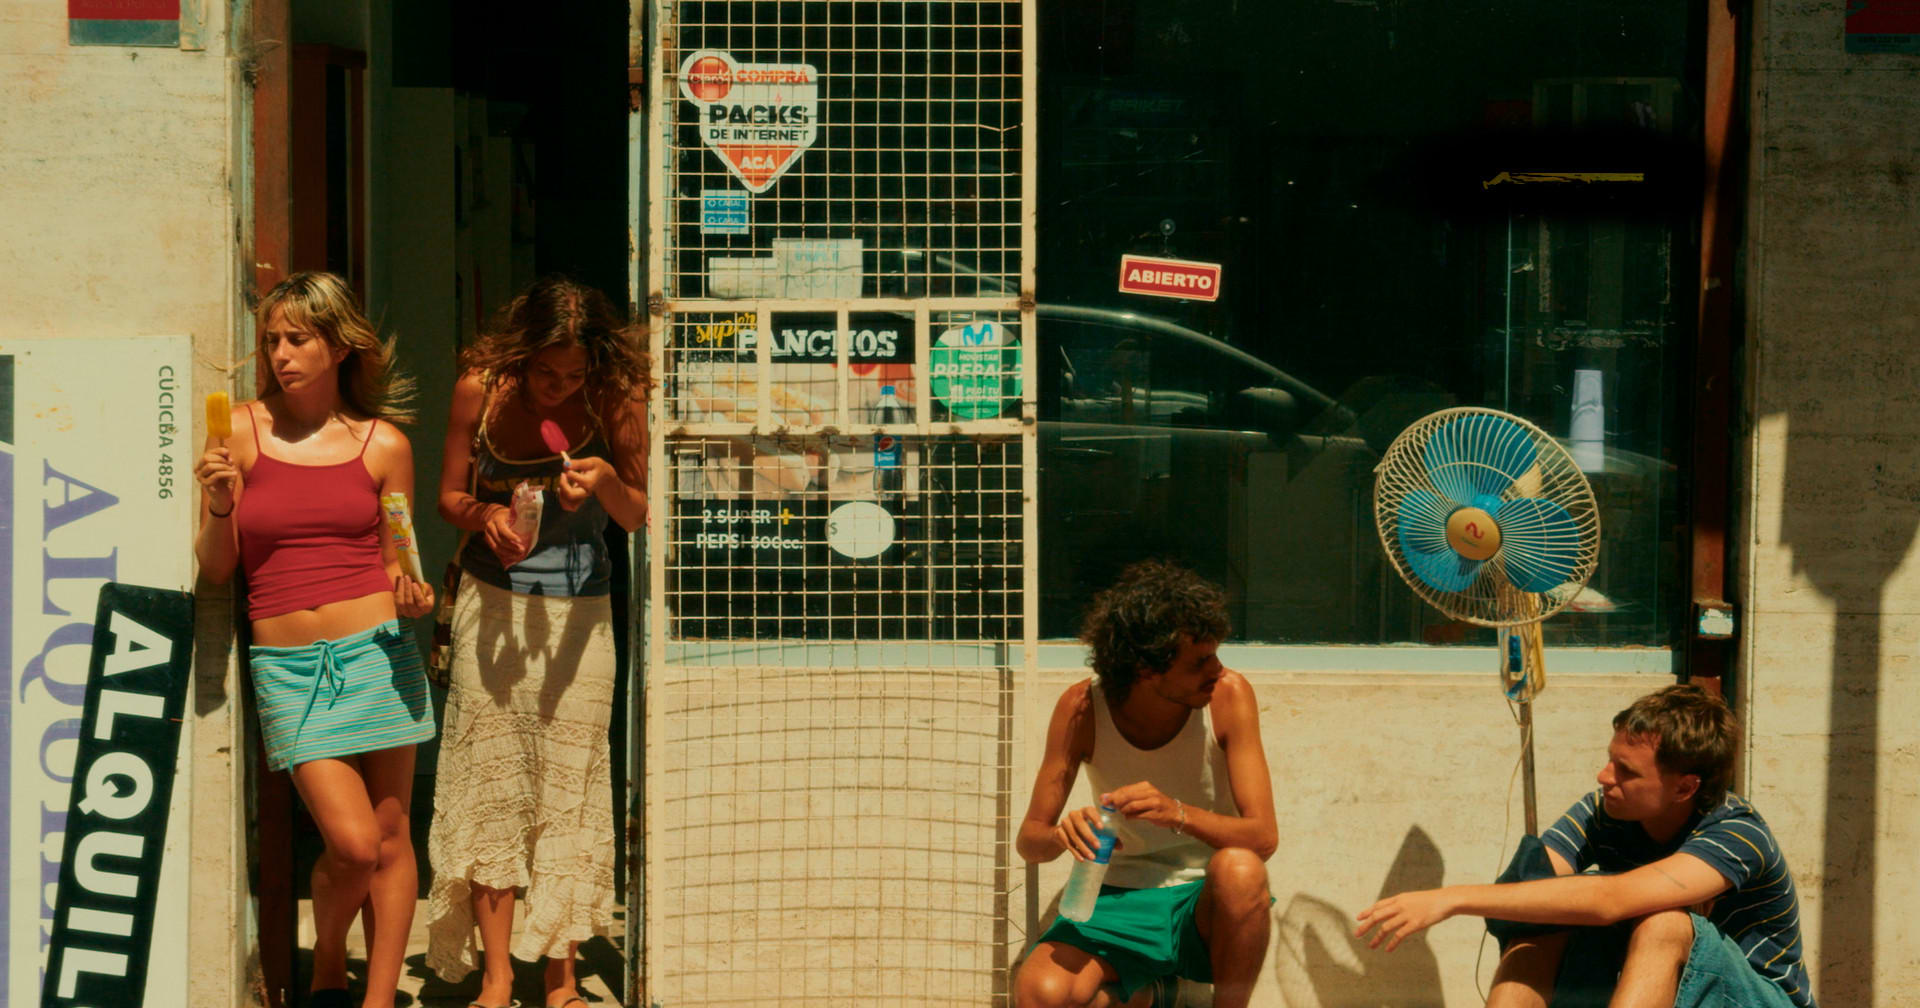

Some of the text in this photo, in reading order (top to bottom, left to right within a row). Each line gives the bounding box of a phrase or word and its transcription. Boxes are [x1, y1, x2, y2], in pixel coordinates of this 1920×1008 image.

[736, 66, 810, 83] COMPRÁ
[709, 104, 809, 127] PACKS
[709, 129, 808, 141] DE INTERNET
[739, 154, 776, 169] ACÁ
[1127, 268, 1212, 290] ABIERTO
[696, 312, 757, 348] super
[738, 329, 898, 357] PANCHOS
[158, 364, 174, 500] CUCICBA 4856
[702, 509, 713, 523] 2
[717, 509, 771, 524] SUPER
[829, 521, 838, 536] $
[696, 533, 745, 549] PEPSI
[57, 610, 173, 1008] ALQUIL
